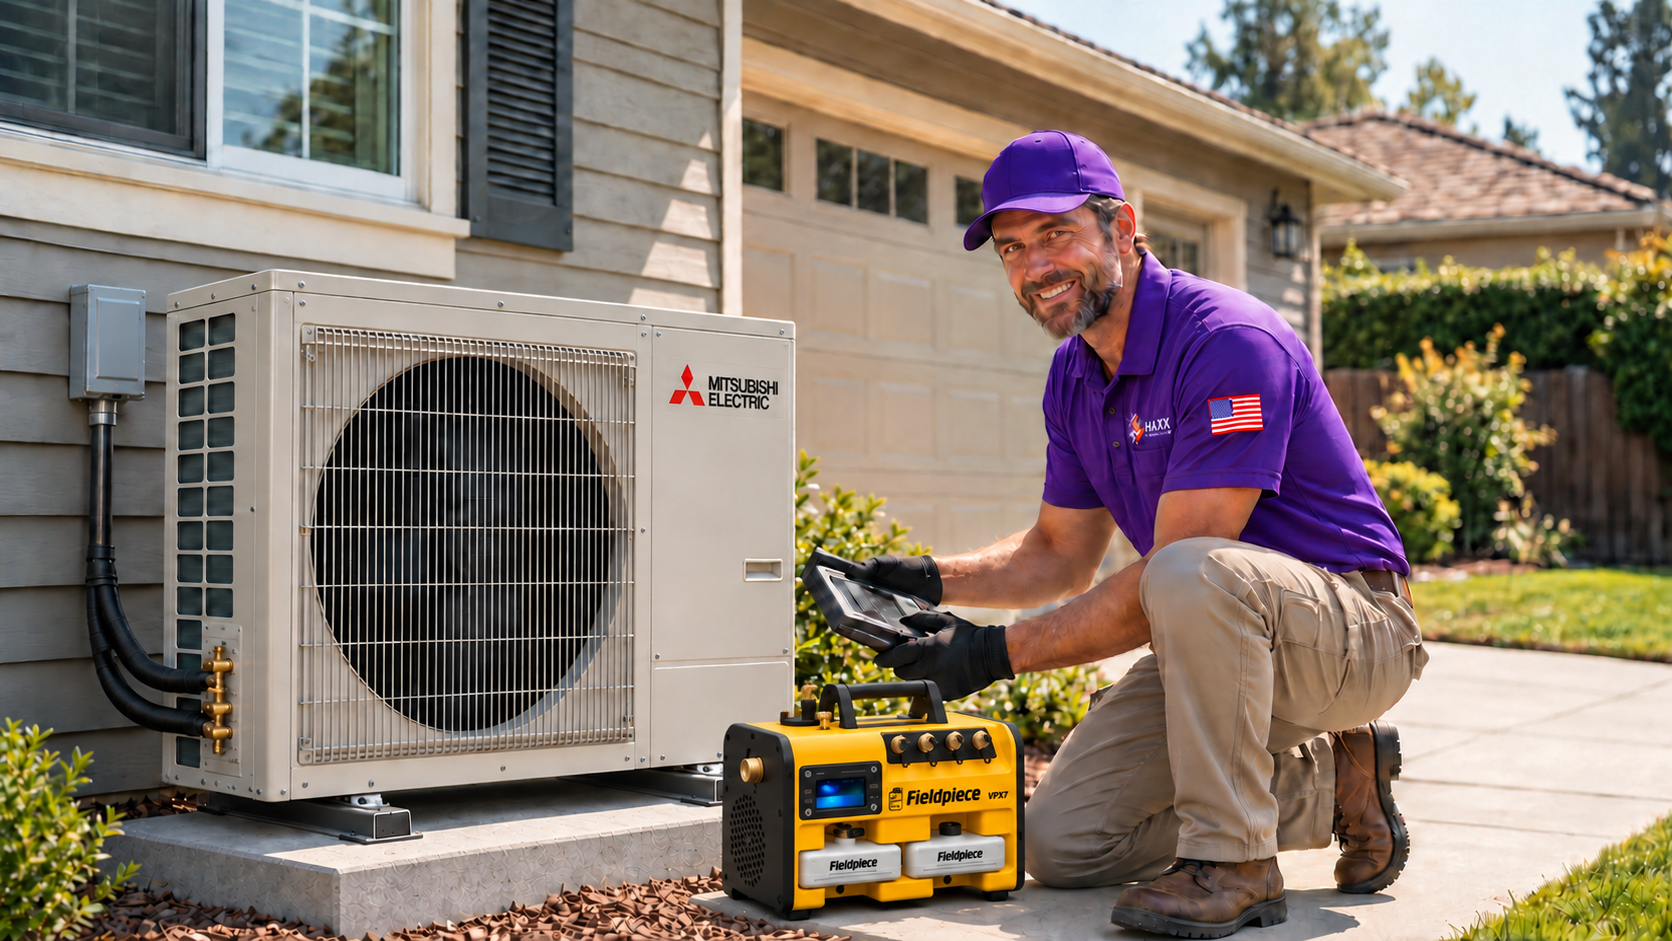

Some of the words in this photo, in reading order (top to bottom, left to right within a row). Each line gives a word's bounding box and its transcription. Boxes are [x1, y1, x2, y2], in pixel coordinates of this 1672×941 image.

[708, 376, 779, 395] MITSUBISHI
[708, 392, 770, 410] ELECTRIC
[1144, 417, 1171, 432] HAXX
[906, 787, 981, 806] Fieldpiece
[988, 791, 1009, 800] VPX7
[937, 849, 984, 862] Fieldpiece
[829, 858, 878, 871] Fieldpiece
